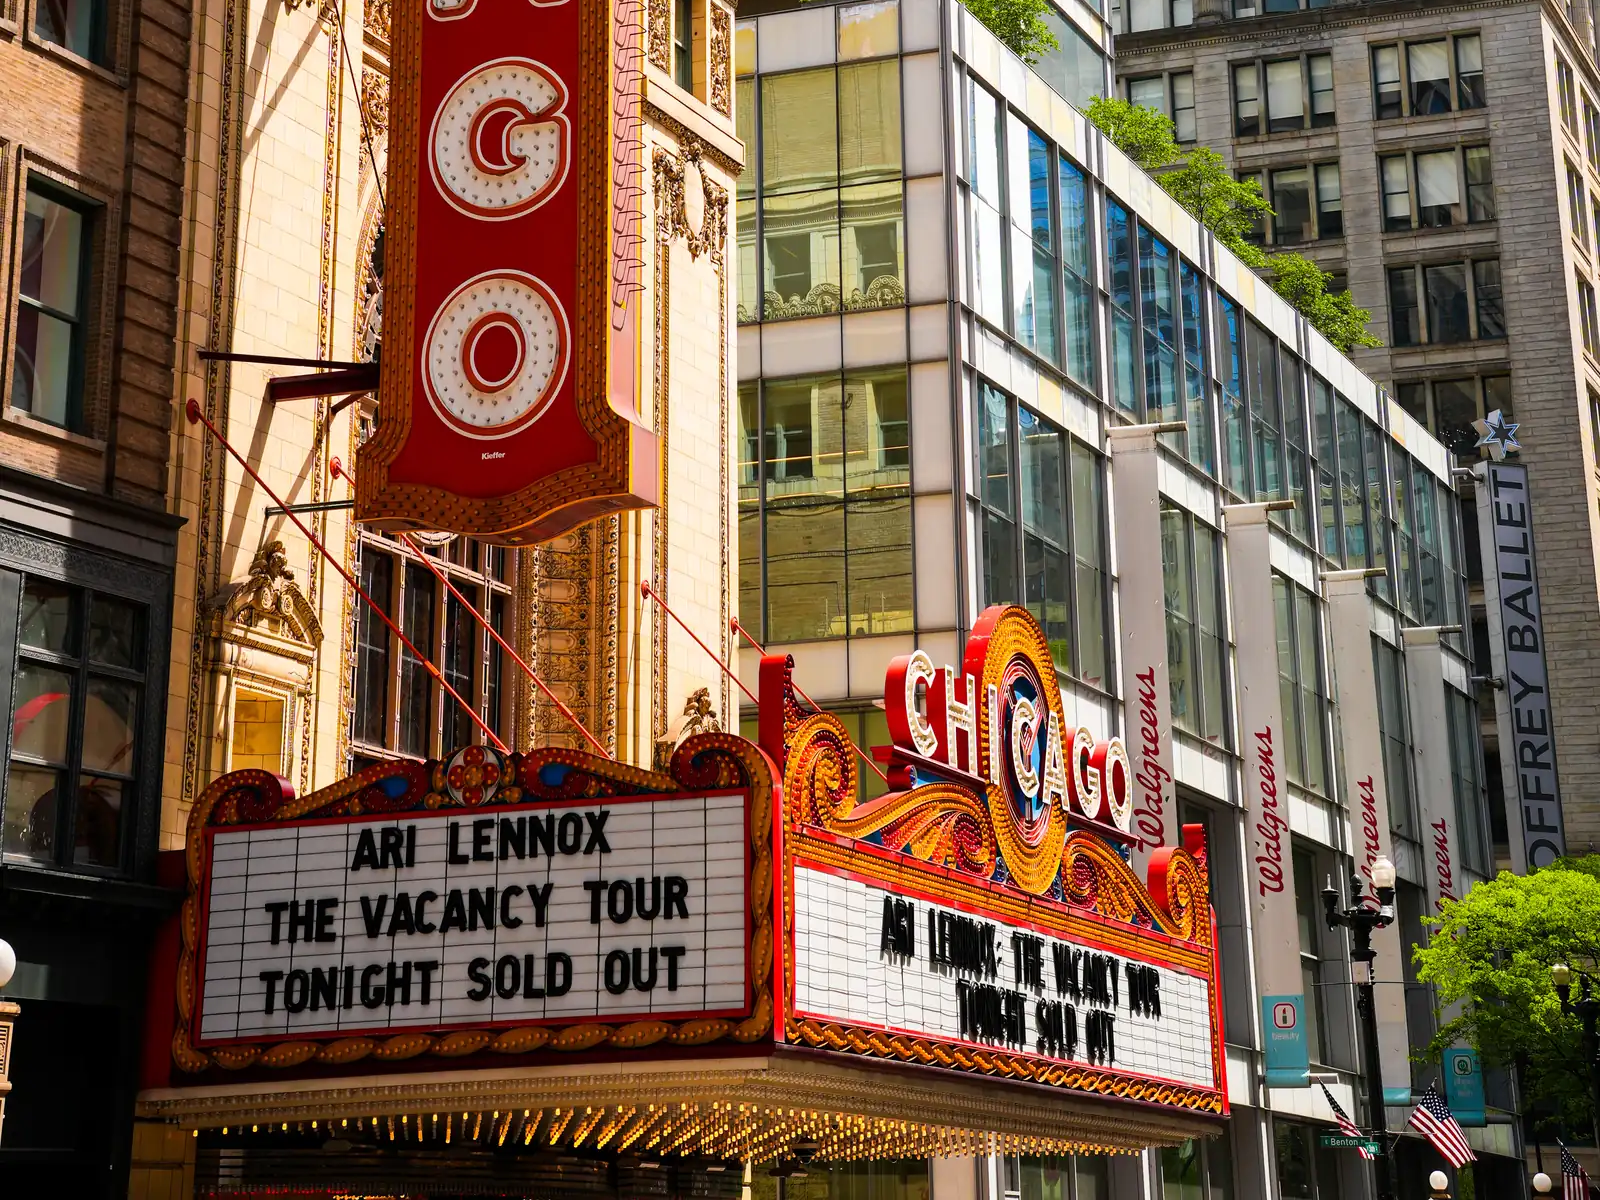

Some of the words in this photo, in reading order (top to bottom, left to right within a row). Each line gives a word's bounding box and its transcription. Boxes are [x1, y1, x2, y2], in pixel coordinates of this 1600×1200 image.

[481, 451, 506, 460] Kieffer
[1492, 469, 1540, 654] BALLET
[904, 649, 1133, 833] CHICAGO
[1134, 666, 1172, 853] Walgreens
[1511, 671, 1561, 869] OFFREY
[352, 825, 416, 872] ARI
[447, 810, 612, 865] LENNOX
[1254, 725, 1289, 897] Walgreens
[265, 898, 338, 945] THE
[360, 883, 555, 938] VACANCY
[584, 876, 689, 925] TOUR
[880, 895, 915, 962] ARI
[1012, 930, 1046, 990] THE
[260, 961, 439, 1015] TONIGHT
[467, 951, 573, 1002] SOLD
[604, 946, 687, 995] OUT
[1330, 1137, 1359, 1146] Benton
